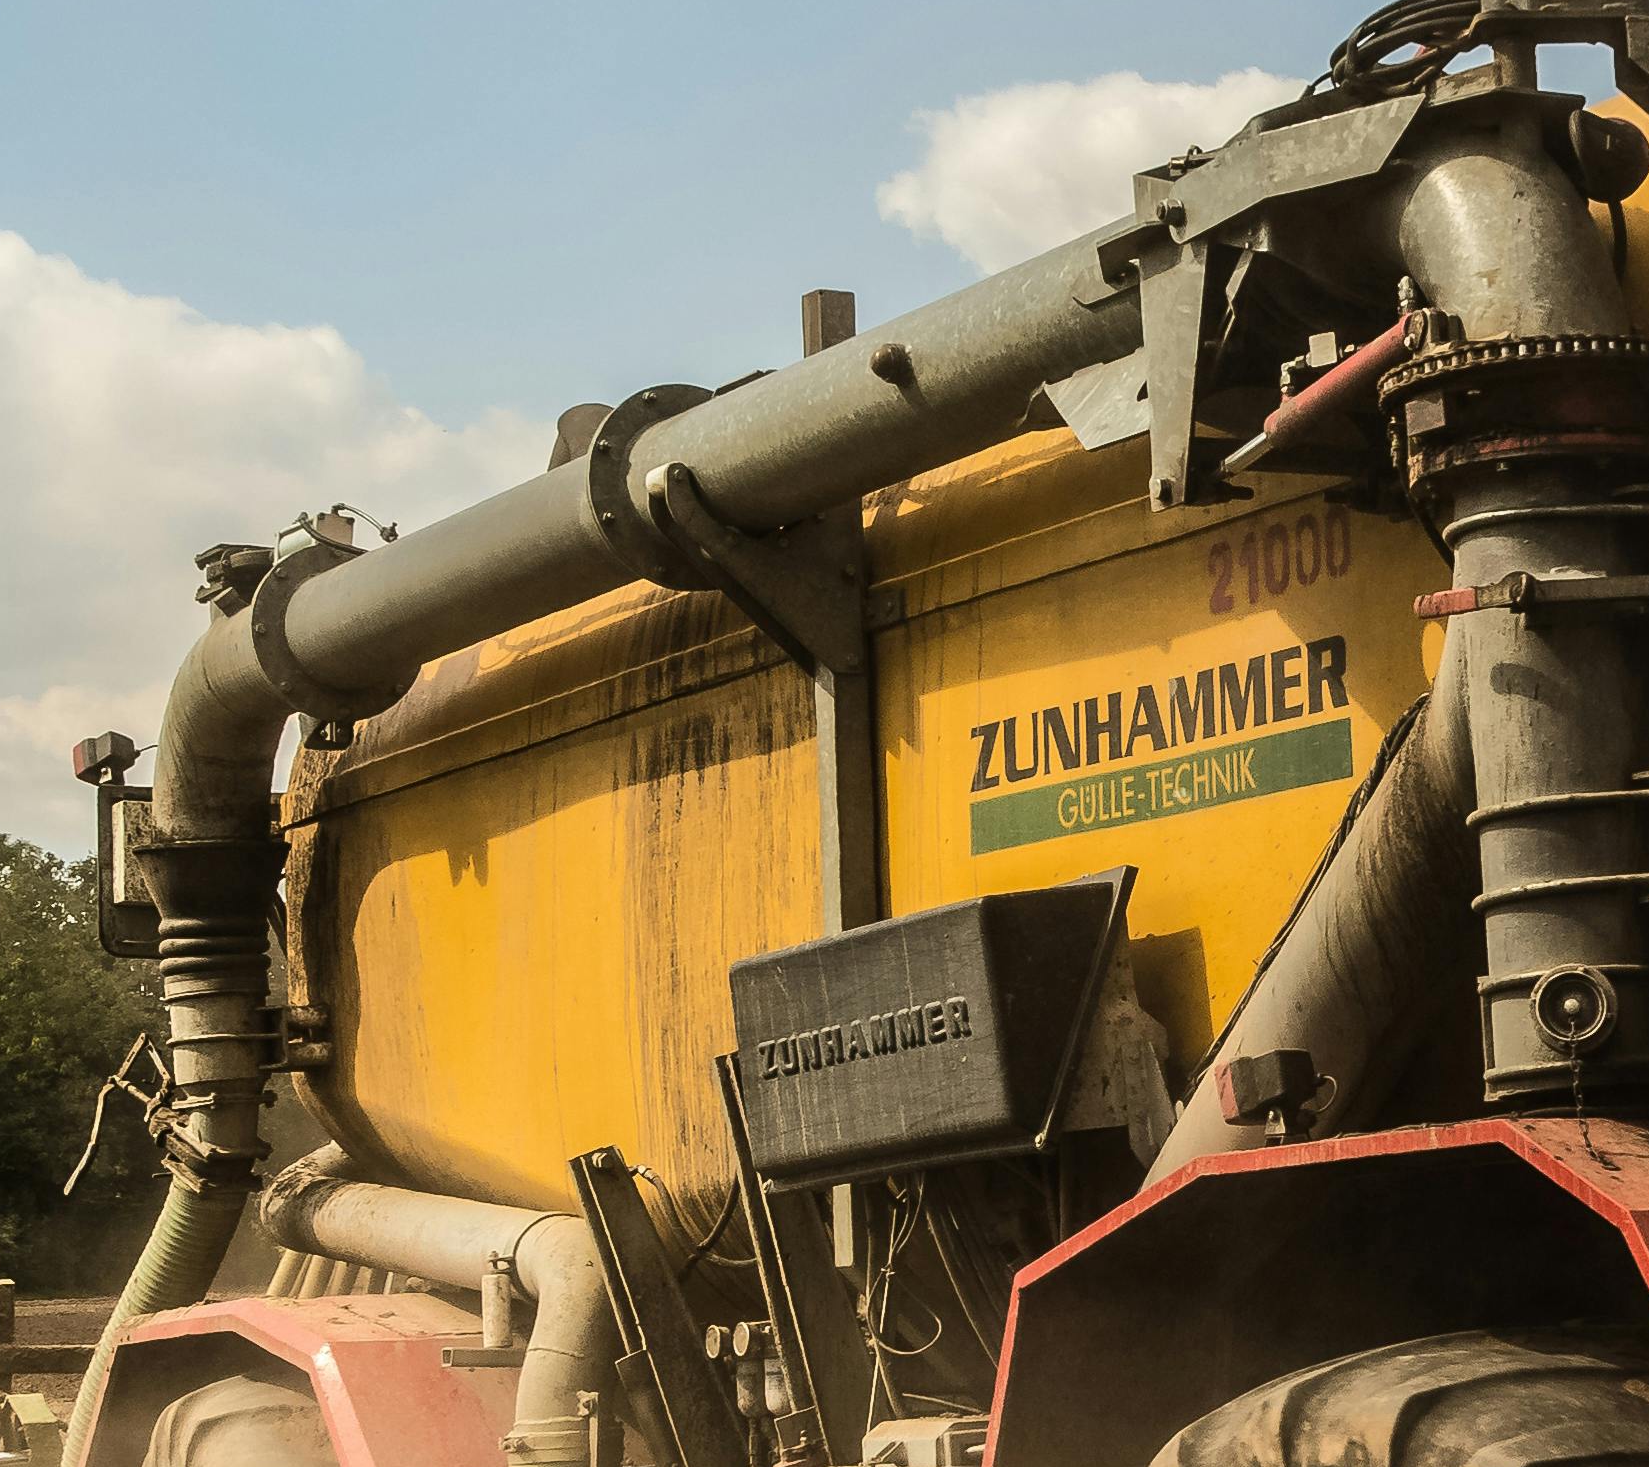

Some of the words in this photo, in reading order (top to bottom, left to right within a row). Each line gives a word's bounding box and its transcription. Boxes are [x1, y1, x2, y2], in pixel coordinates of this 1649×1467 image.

[1207, 509, 1350, 615] 21000
[970, 635, 1349, 793] ZUNHAMMER
[1057, 747, 1257, 830] GÜLLE-TECHNIK
[756, 994, 973, 1081] ZUNHAMMER
